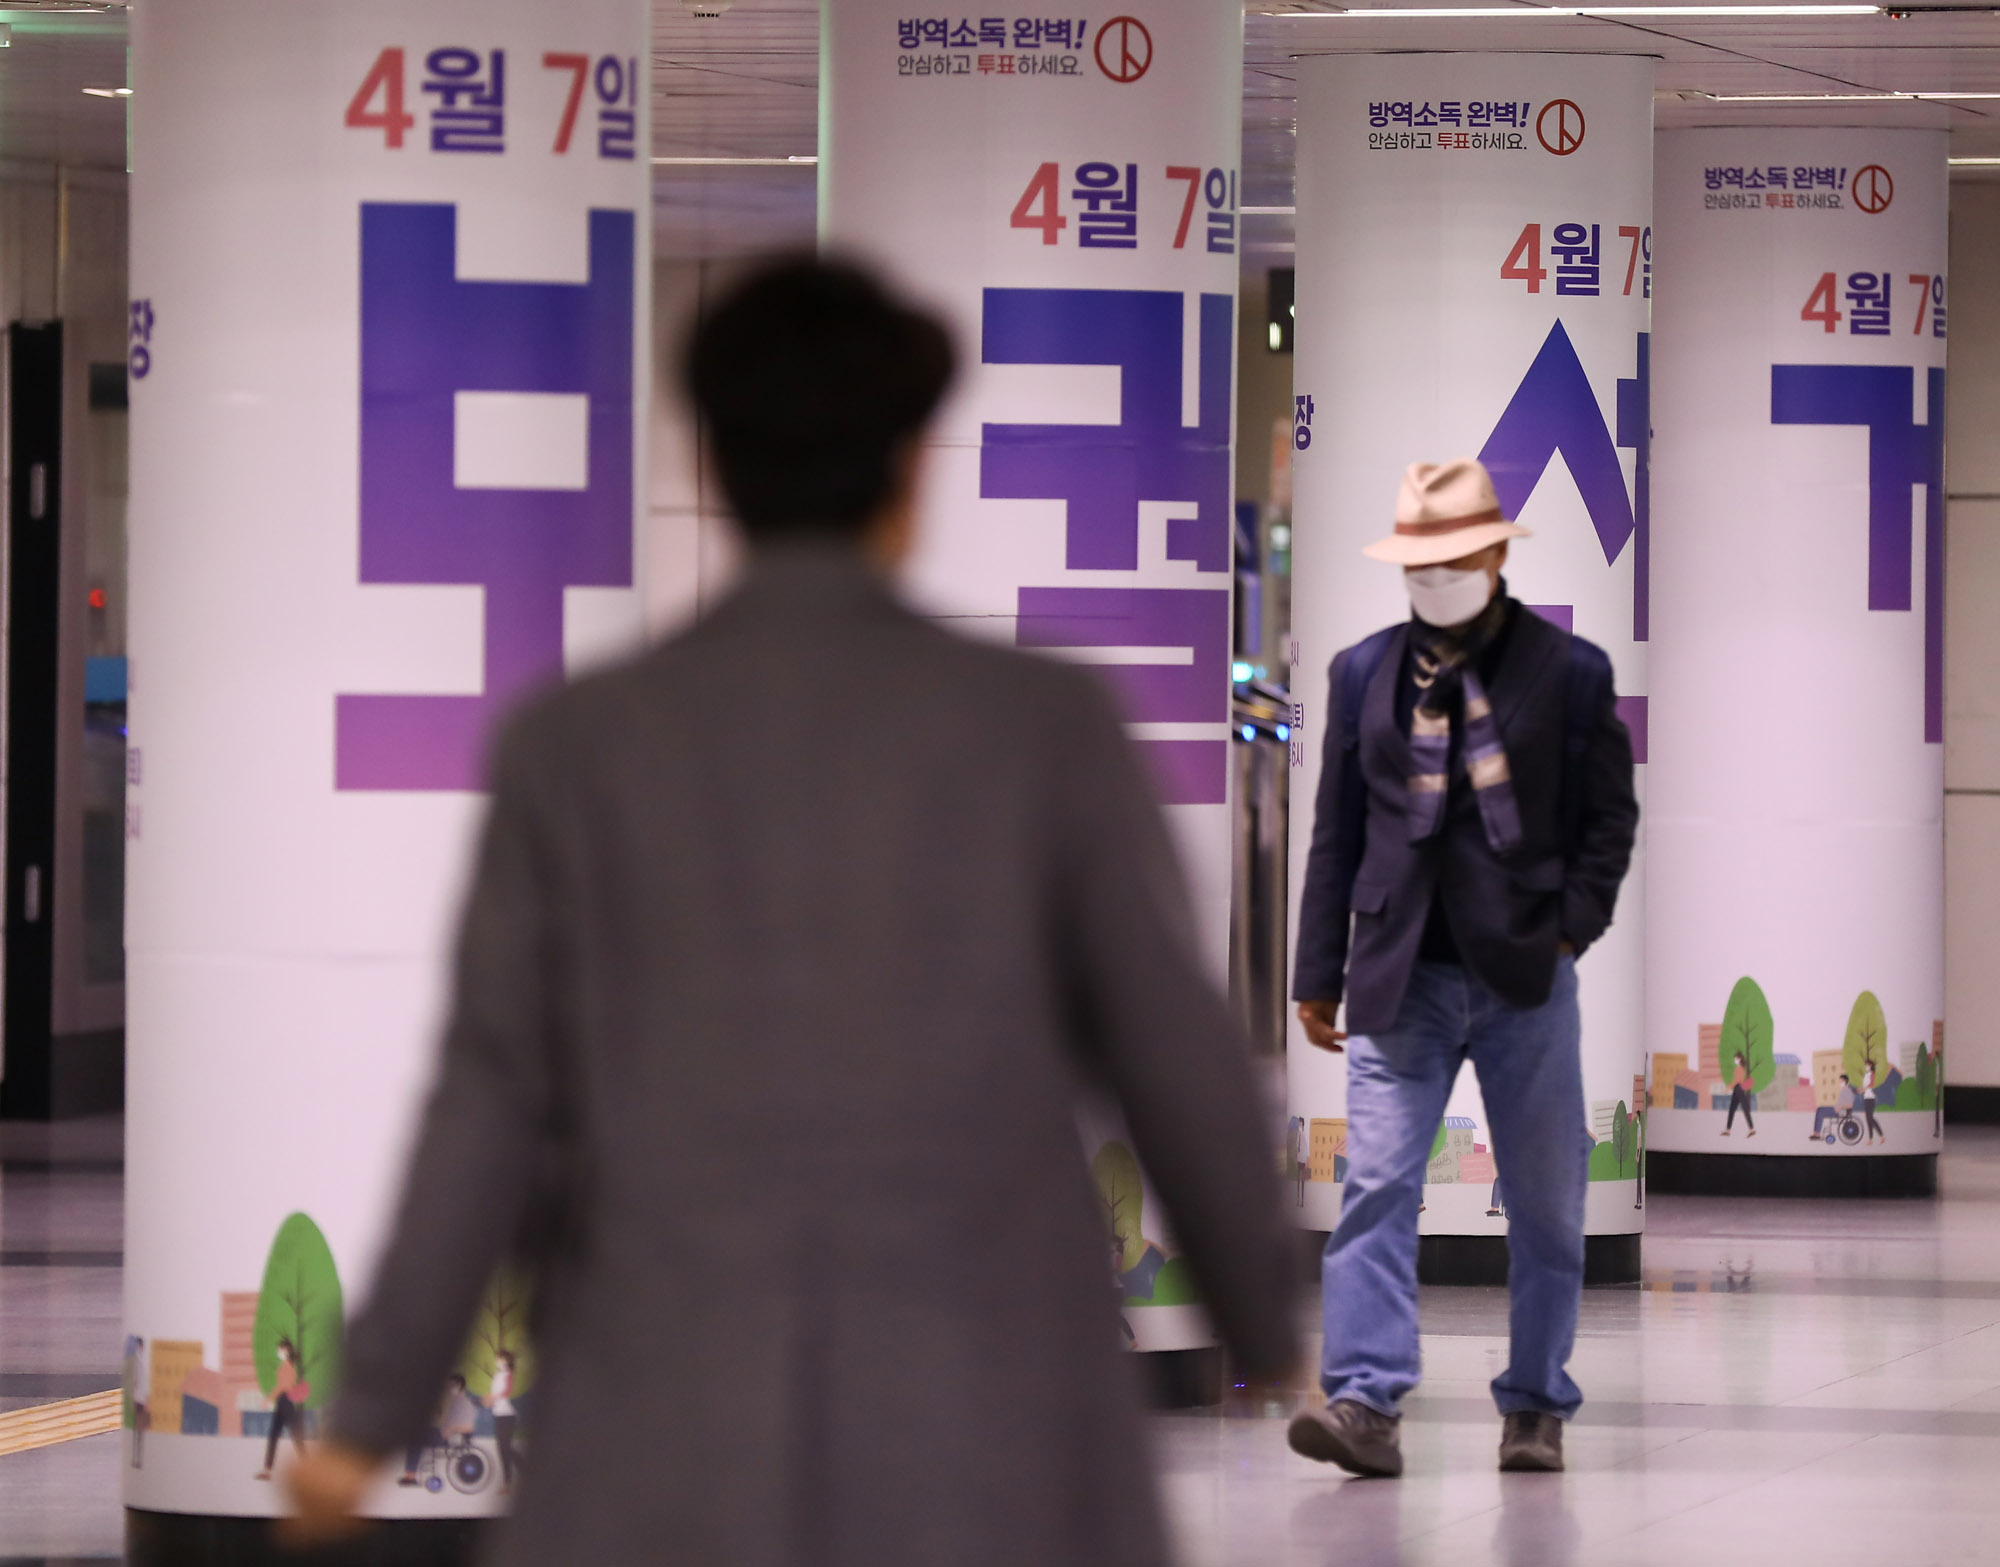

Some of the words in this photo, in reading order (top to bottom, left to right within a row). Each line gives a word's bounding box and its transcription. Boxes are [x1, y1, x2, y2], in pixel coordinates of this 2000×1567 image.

[897, 17, 1006, 49] 방역소독
[1013, 17, 1087, 49] 완벽!
[897, 54, 971, 76] 안심하고
[976, 53, 1084, 76] 투표하세요.
[344, 46, 507, 154] 4월
[541, 52, 637, 160] 7일
[1368, 101, 1462, 128] 방역소독
[1467, 101, 1531, 128] 완벽!
[1368, 132, 1432, 150] 안심하고
[1436, 132, 1528, 150] 투표하세요.
[1704, 166, 1788, 190] 방역소독
[1792, 166, 1847, 190] 완벽!
[1009, 161, 1138, 249] 4월
[1165, 165, 1236, 254] 7일
[1704, 193, 1761, 210] 안심하고
[1764, 193, 1845, 210] 투표하세요.
[1500, 222, 1601, 297] 4월
[1800, 271, 1892, 337] 4월
